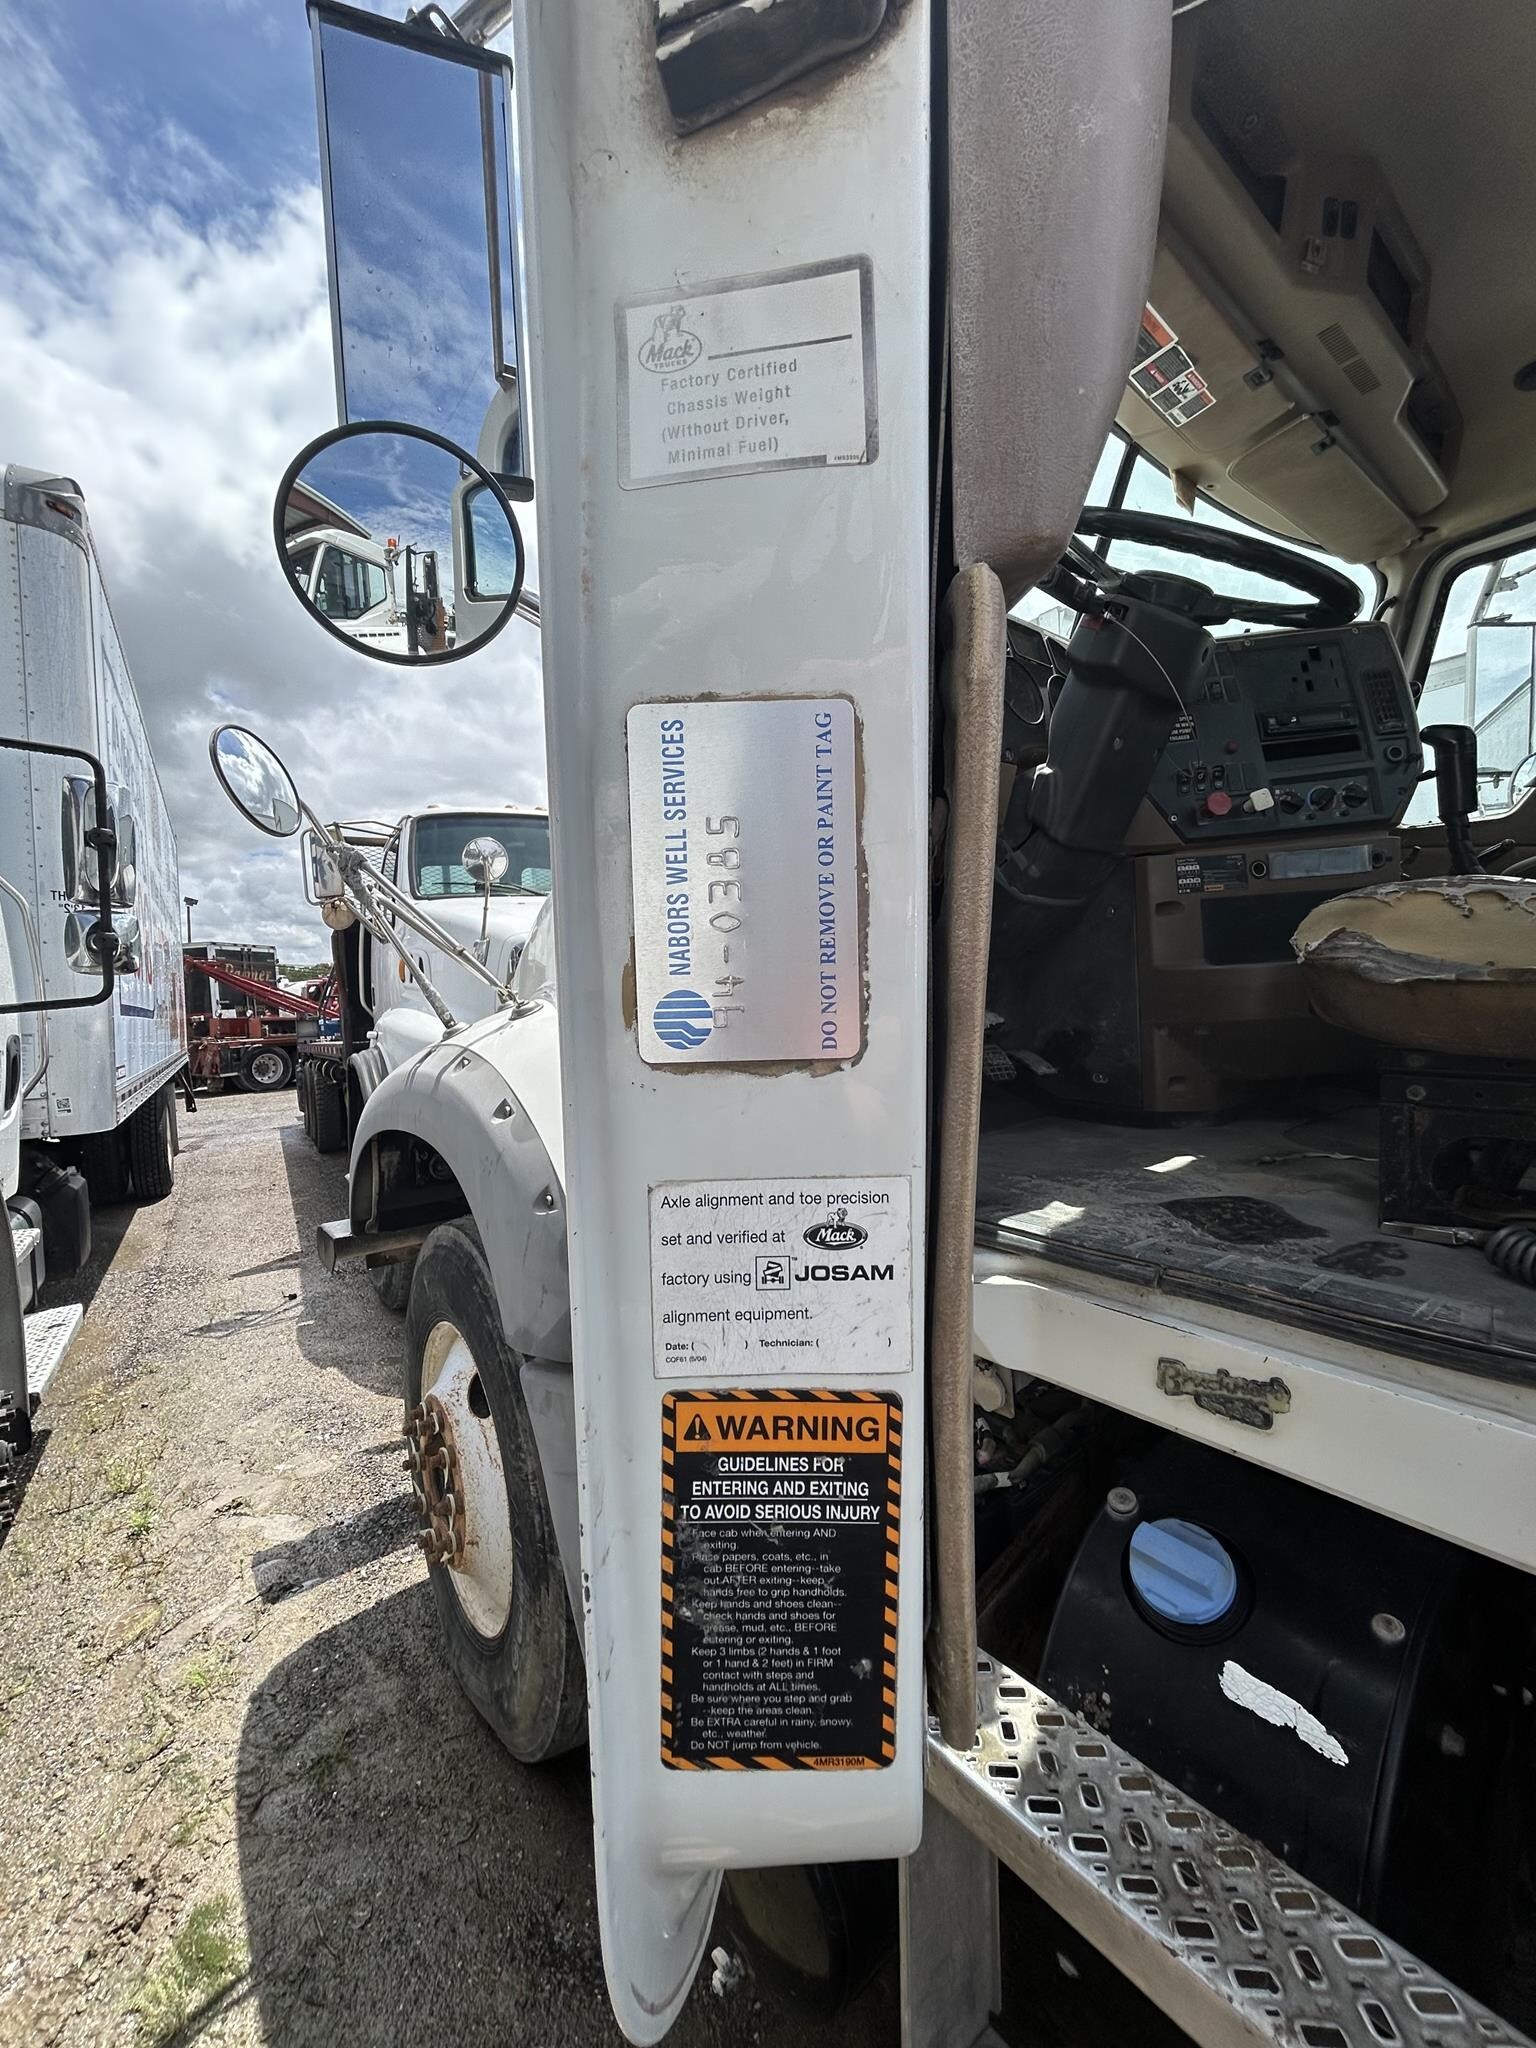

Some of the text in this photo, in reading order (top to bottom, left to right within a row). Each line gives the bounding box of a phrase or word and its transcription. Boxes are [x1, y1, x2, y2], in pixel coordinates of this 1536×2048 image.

[646, 339, 694, 364] Mack
[661, 359, 798, 392] Factory Certified
[667, 384, 792, 415] Chassis Weight
[662, 412, 789, 443] (Without Driver,
[668, 437, 779, 464] Minimal Fuel)
[661, 719, 691, 976] NABORS WELL SERVICES
[814, 712, 838, 1050] DO NOT REMOVE OR PAINT TAG
[661, 1191, 889, 1209] Axle alignment and toe precision
[662, 1230, 785, 1245] set and verified at
[815, 1227, 857, 1242] Mack
[795, 1265, 893, 1281] JOSAM
[662, 1273, 751, 1287] factory using
[663, 1308, 812, 1326] alignment equipment.
[665, 1342, 689, 1351] Date:
[760, 1338, 813, 1348] Technician:
[716, 1416, 880, 1441] WARNING
[718, 1457, 844, 1473] GUIDELINES FOR
[692, 1481, 869, 1497] ENTERING AND EXITING
[680, 1505, 880, 1520] TO AVOID SERIOUS INJURY
[720, 1529, 737, 1537] cab
[741, 1529, 767, 1537] when
[813, 1529, 836, 1537] AND
[723, 1553, 758, 1563] papers,
[762, 1553, 792, 1563] coats,
[796, 1553, 816, 1563] etc.,
[820, 1553, 828, 1561] in
[704, 1565, 722, 1573] cab
[726, 1565, 767, 1573] BEFORE
[704, 1588, 846, 1598] hands free to grip handholds.
[692, 1600, 717, 1610] Keep
[720, 1600, 750, 1608] hands
[753, 1600, 771, 1608] and
[775, 1600, 804, 1608] shoes
[703, 1612, 835, 1620] check hands and shoes for
[742, 1624, 766, 1634] mud,
[770, 1624, 791, 1634] etc.,
[795, 1624, 836, 1632] BEFORE
[703, 1636, 742, 1646] entering
[759, 1636, 793, 1646] exiting.
[692, 1647, 840, 1657] Keep 3 limbs (2 hands & 1 foot
[717, 1659, 720, 1667] 1
[725, 1659, 749, 1667] hand
[752, 1659, 758, 1667] &
[762, 1659, 768, 1667] 2
[772, 1659, 793, 1669] feet)
[796, 1659, 804, 1667] in
[808, 1659, 833, 1667] FIRM
[703, 1671, 813, 1681] contact with steps and
[703, 1683, 820, 1691] handholds at ALL times.
[692, 1694, 704, 1703] Be
[731, 1694, 760, 1703] where
[764, 1696, 781, 1704] you
[785, 1694, 805, 1704] step
[809, 1694, 826, 1703] and
[830, 1694, 852, 1704] grab
[738, 1706, 753, 1714] the
[786, 1706, 812, 1714] clean.
[691, 1718, 704, 1726] Be
[707, 1718, 741, 1726] EXTRA
[744, 1718, 776, 1726] careful
[780, 1718, 788, 1726] in
[792, 1718, 816, 1728] rainy,
[703, 1729, 723, 1739] etc.,
[691, 1741, 821, 1751] Do NOT jump from vehicle.
